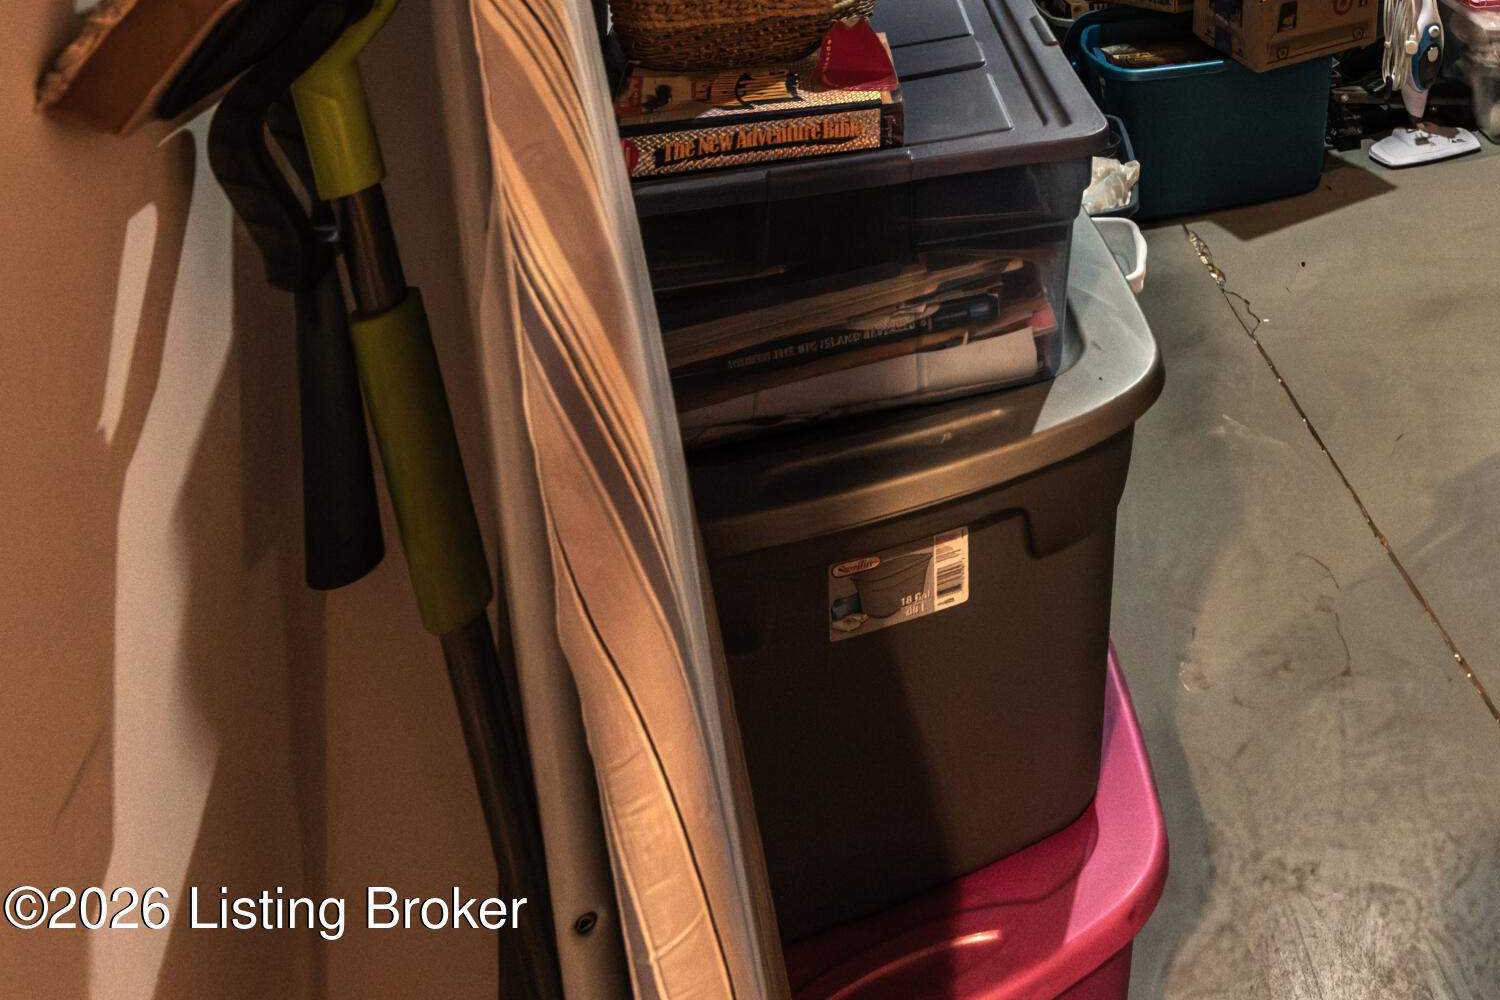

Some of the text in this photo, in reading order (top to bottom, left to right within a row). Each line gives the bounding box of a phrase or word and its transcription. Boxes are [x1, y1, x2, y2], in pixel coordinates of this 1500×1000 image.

[662, 142, 697, 163] The
[697, 134, 735, 156] New
[734, 122, 823, 150] Adventure
[822, 119, 861, 140] Bible
[900, 594, 913, 606] 18
